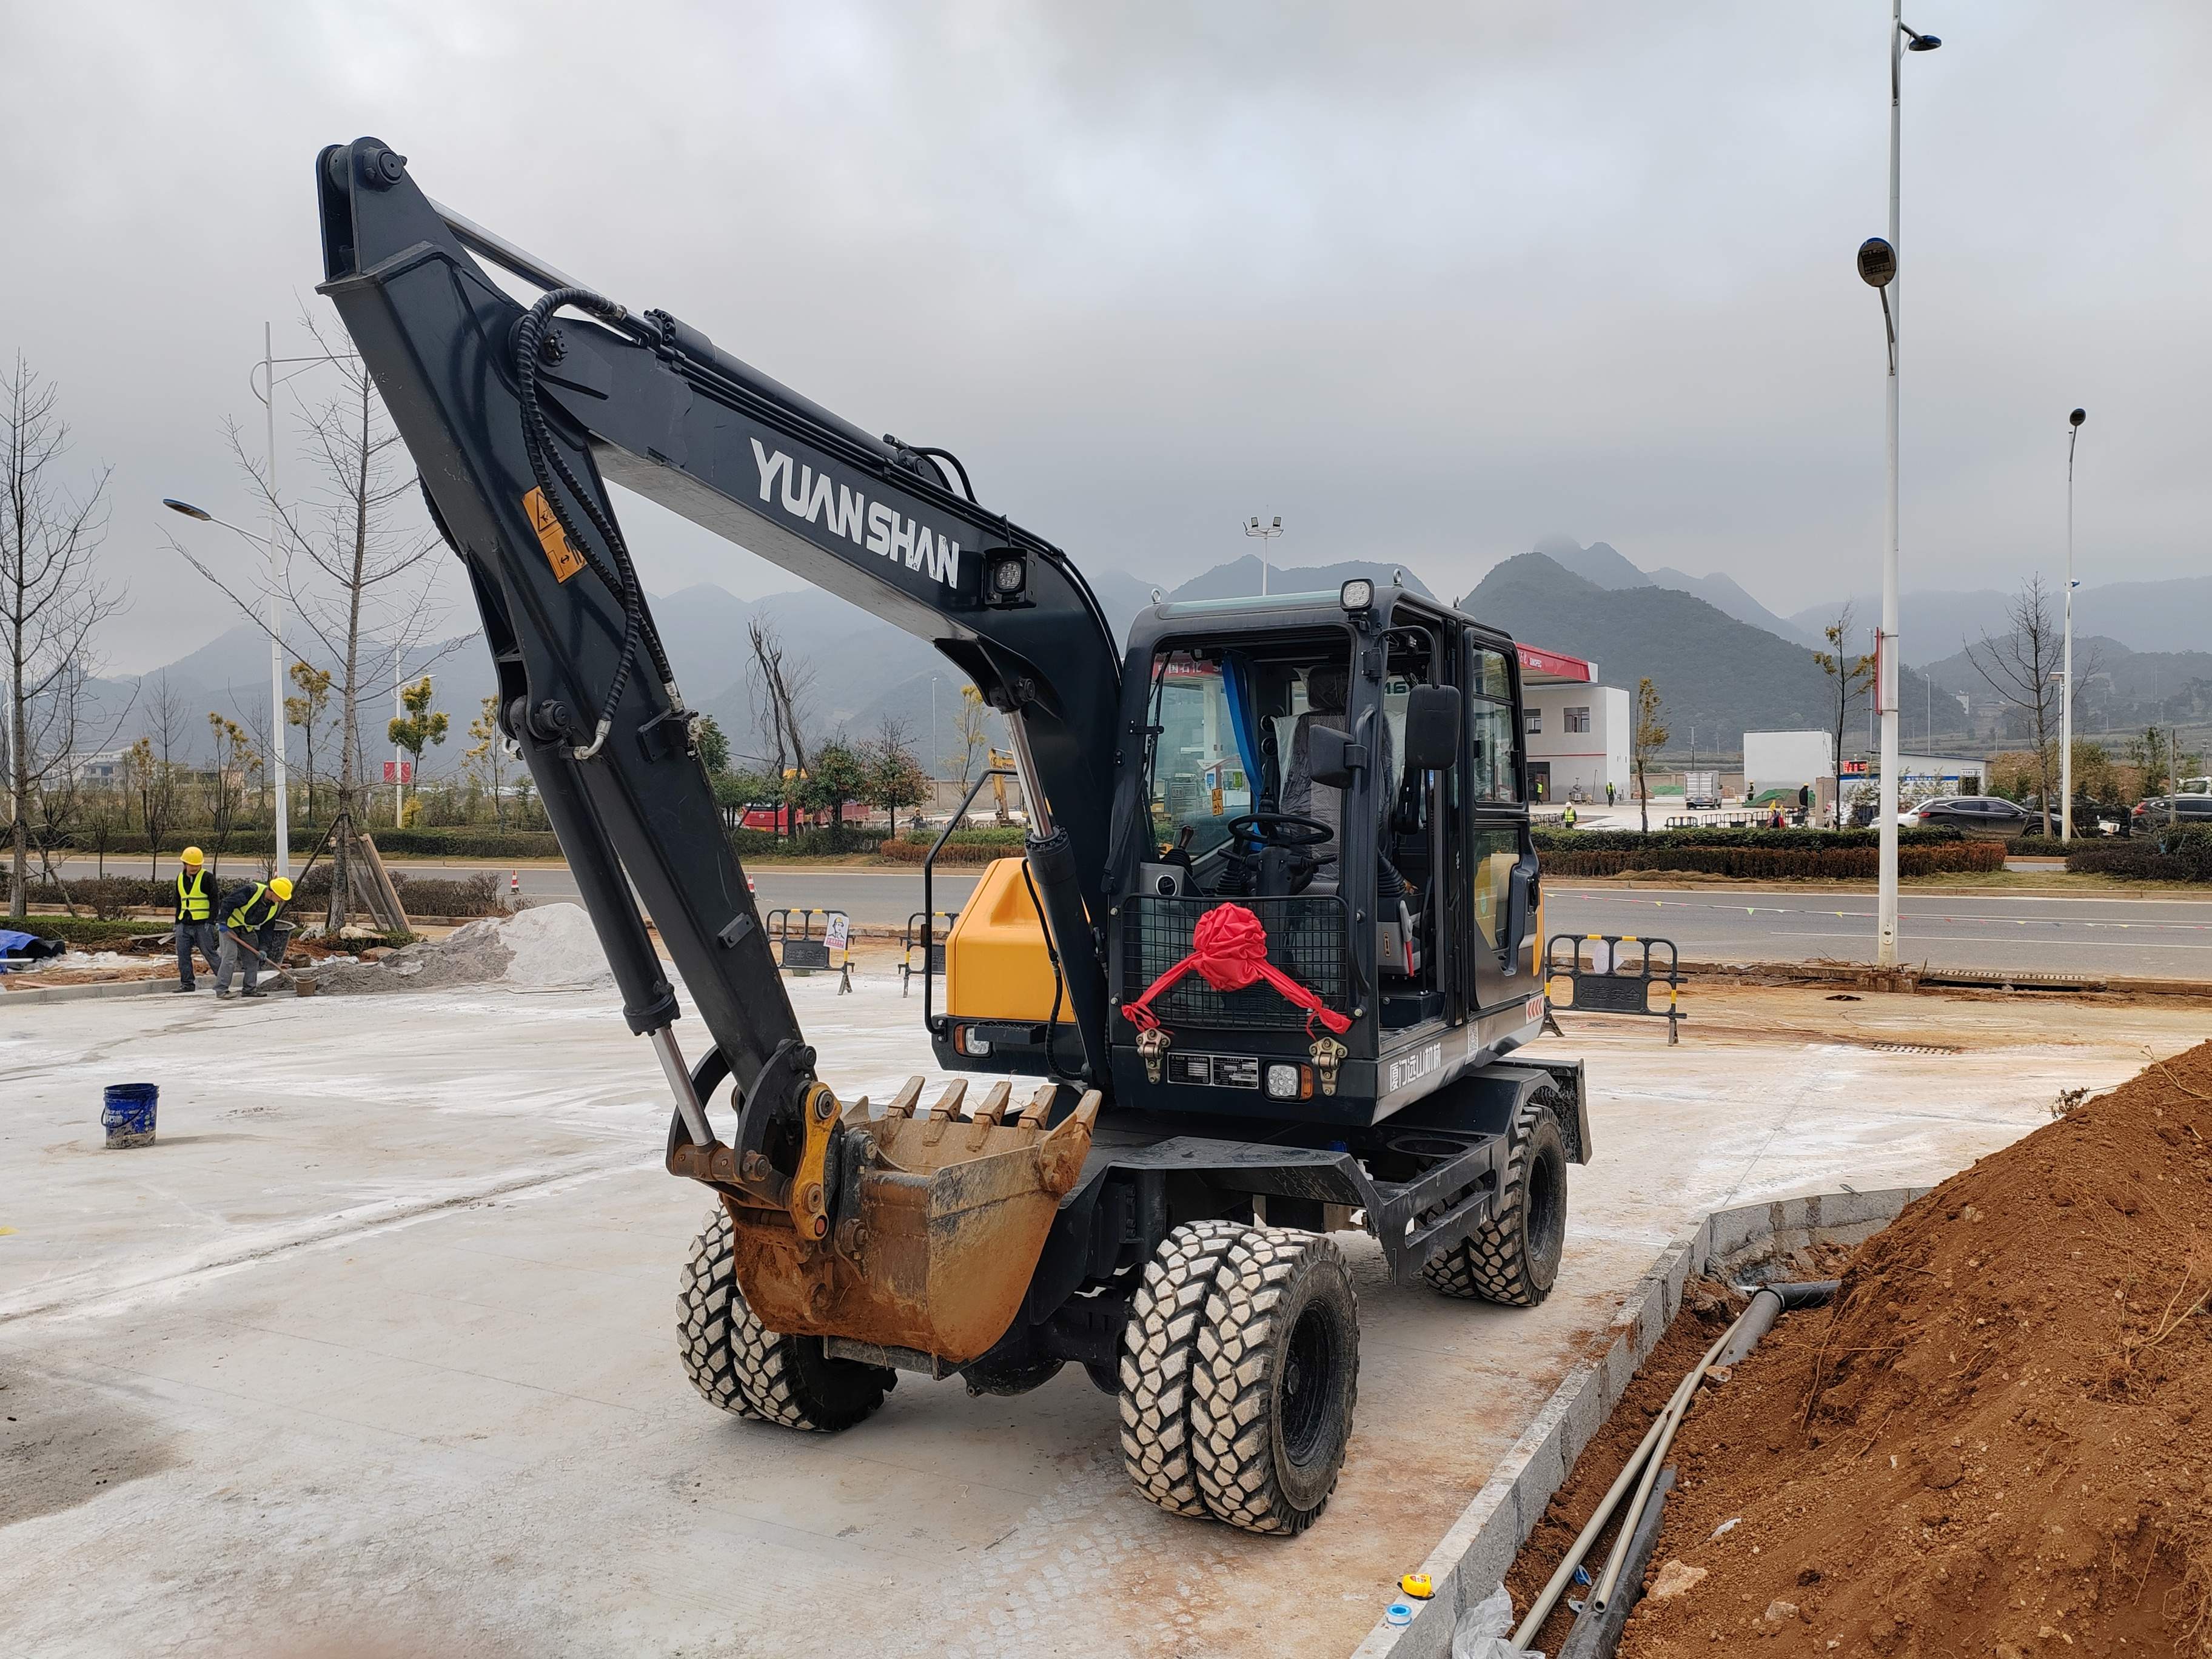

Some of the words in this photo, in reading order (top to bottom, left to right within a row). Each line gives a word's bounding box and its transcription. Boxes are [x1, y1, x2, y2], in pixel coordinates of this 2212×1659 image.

[750, 437, 959, 589] YUANSHAN
[1580, 985, 1640, 1003] 注意安全
[1390, 1042, 1441, 1092] 厦门远山机械
